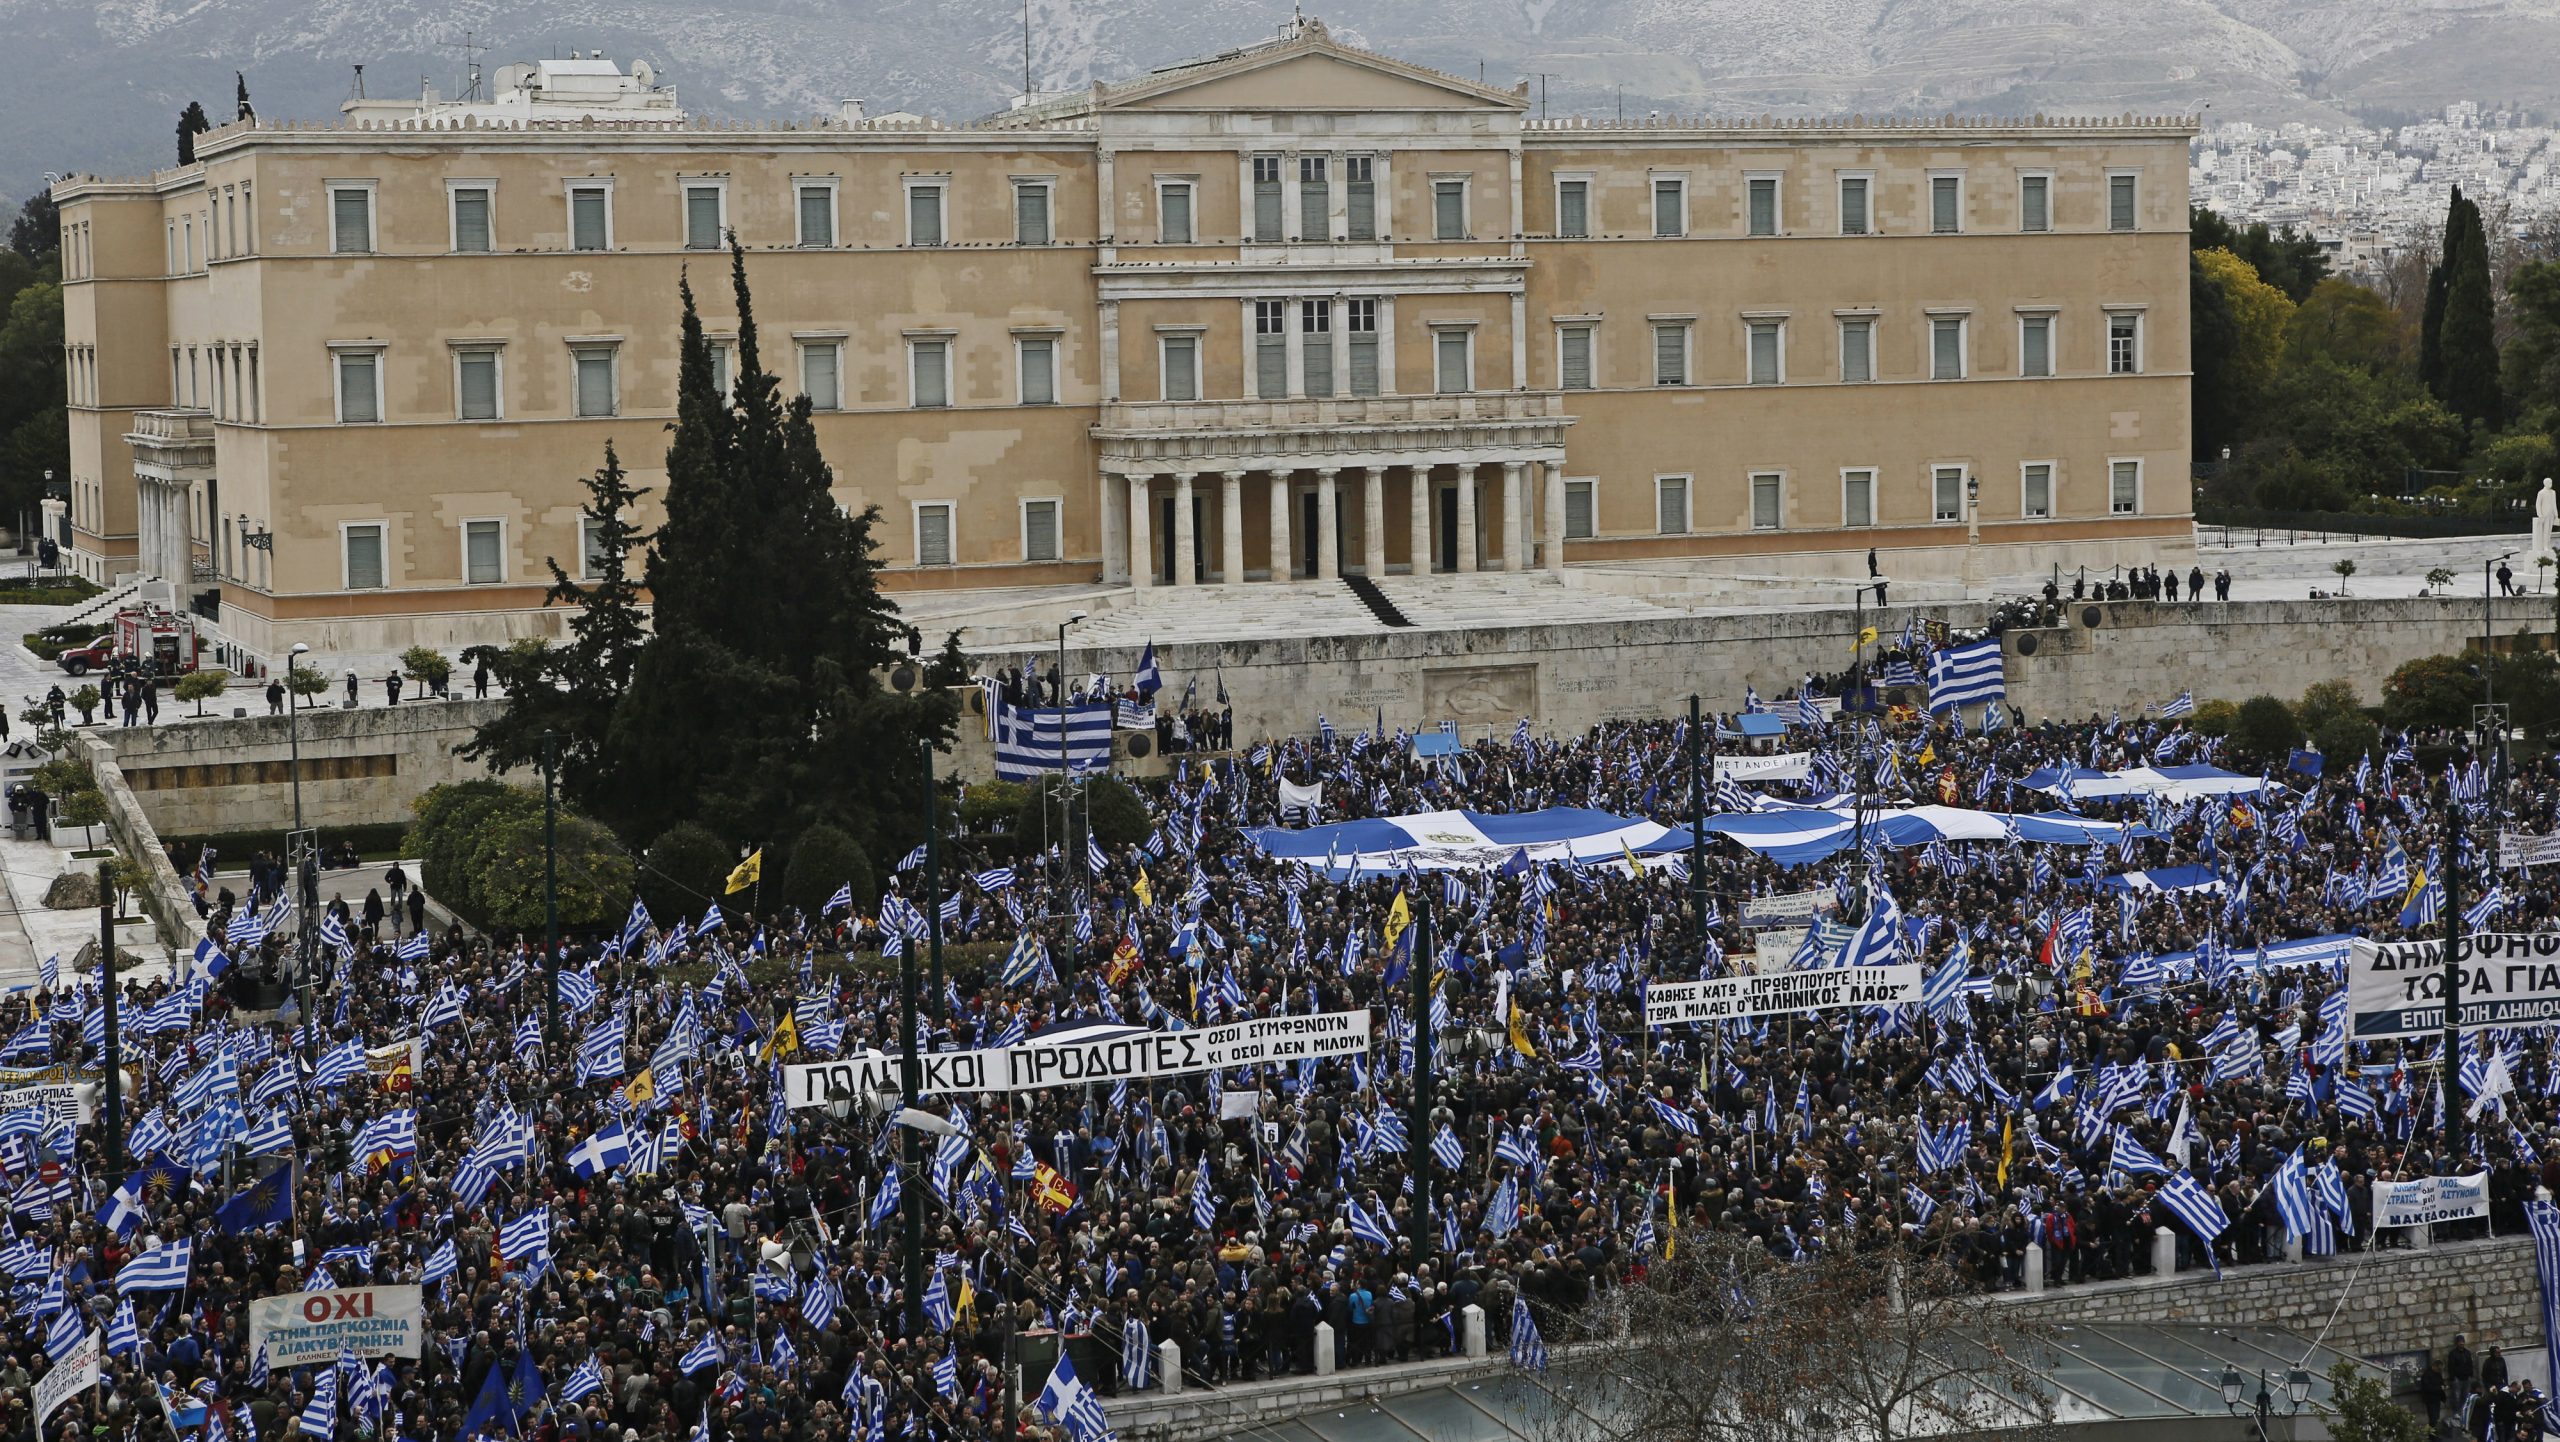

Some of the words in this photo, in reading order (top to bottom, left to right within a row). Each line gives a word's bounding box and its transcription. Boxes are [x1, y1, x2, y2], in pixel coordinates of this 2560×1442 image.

[1715, 757, 1806, 769] ΜΕΤΑΝΟΕΙΤΕ
[1647, 987, 1696, 1004] ΚΑΘΗΣΕ
[1703, 983, 1737, 999] ΚΑΤΩ
[1751, 970, 1850, 994] ΠΡΩΘΥΠΟΥΡΓΕ
[2505, 963, 2560, 993] ΓΙΑ
[1648, 1006, 1678, 1021] ΤΩΡΑ
[1685, 999, 1731, 1016] ΜΙΛΑΕΙ
[2401, 1004, 2490, 1029] ΕΠΙΤΟΠΗ
[1208, 1027, 1240, 1045] ΟΣΟΙ
[1250, 1016, 1348, 1039] ΣΥΜΦΩΝΟΥΝ
[1010, 1034, 1203, 1085] ΠΡΟΔΟΤΕΣ
[1207, 1050, 1222, 1064] ΚΙ
[1232, 1043, 1265, 1061] ΟΣΟΙ
[1273, 1041, 1306, 1055] ΔΕΝ
[1314, 1035, 1365, 1052] ΜΙΛΟΥΝ
[1267, 1129, 1275, 1142] 6
[2438, 1179, 2458, 1189] ΛΑΟΣ
[2441, 1187, 2481, 1200] ΑΣΤΥΝΟΜΙΑ
[2390, 1206, 2475, 1226] ΜΑΚΕΔΟΝΙΑ
[304, 1292, 373, 1323] ΟΧΙ
[268, 1327, 310, 1343] ΣΤΗΝ
[316, 1319, 409, 1337] ΠΑΓΚΟΣΜΙΑ
[296, 1351, 332, 1362] ΕΛΛΗΝΕΣ
